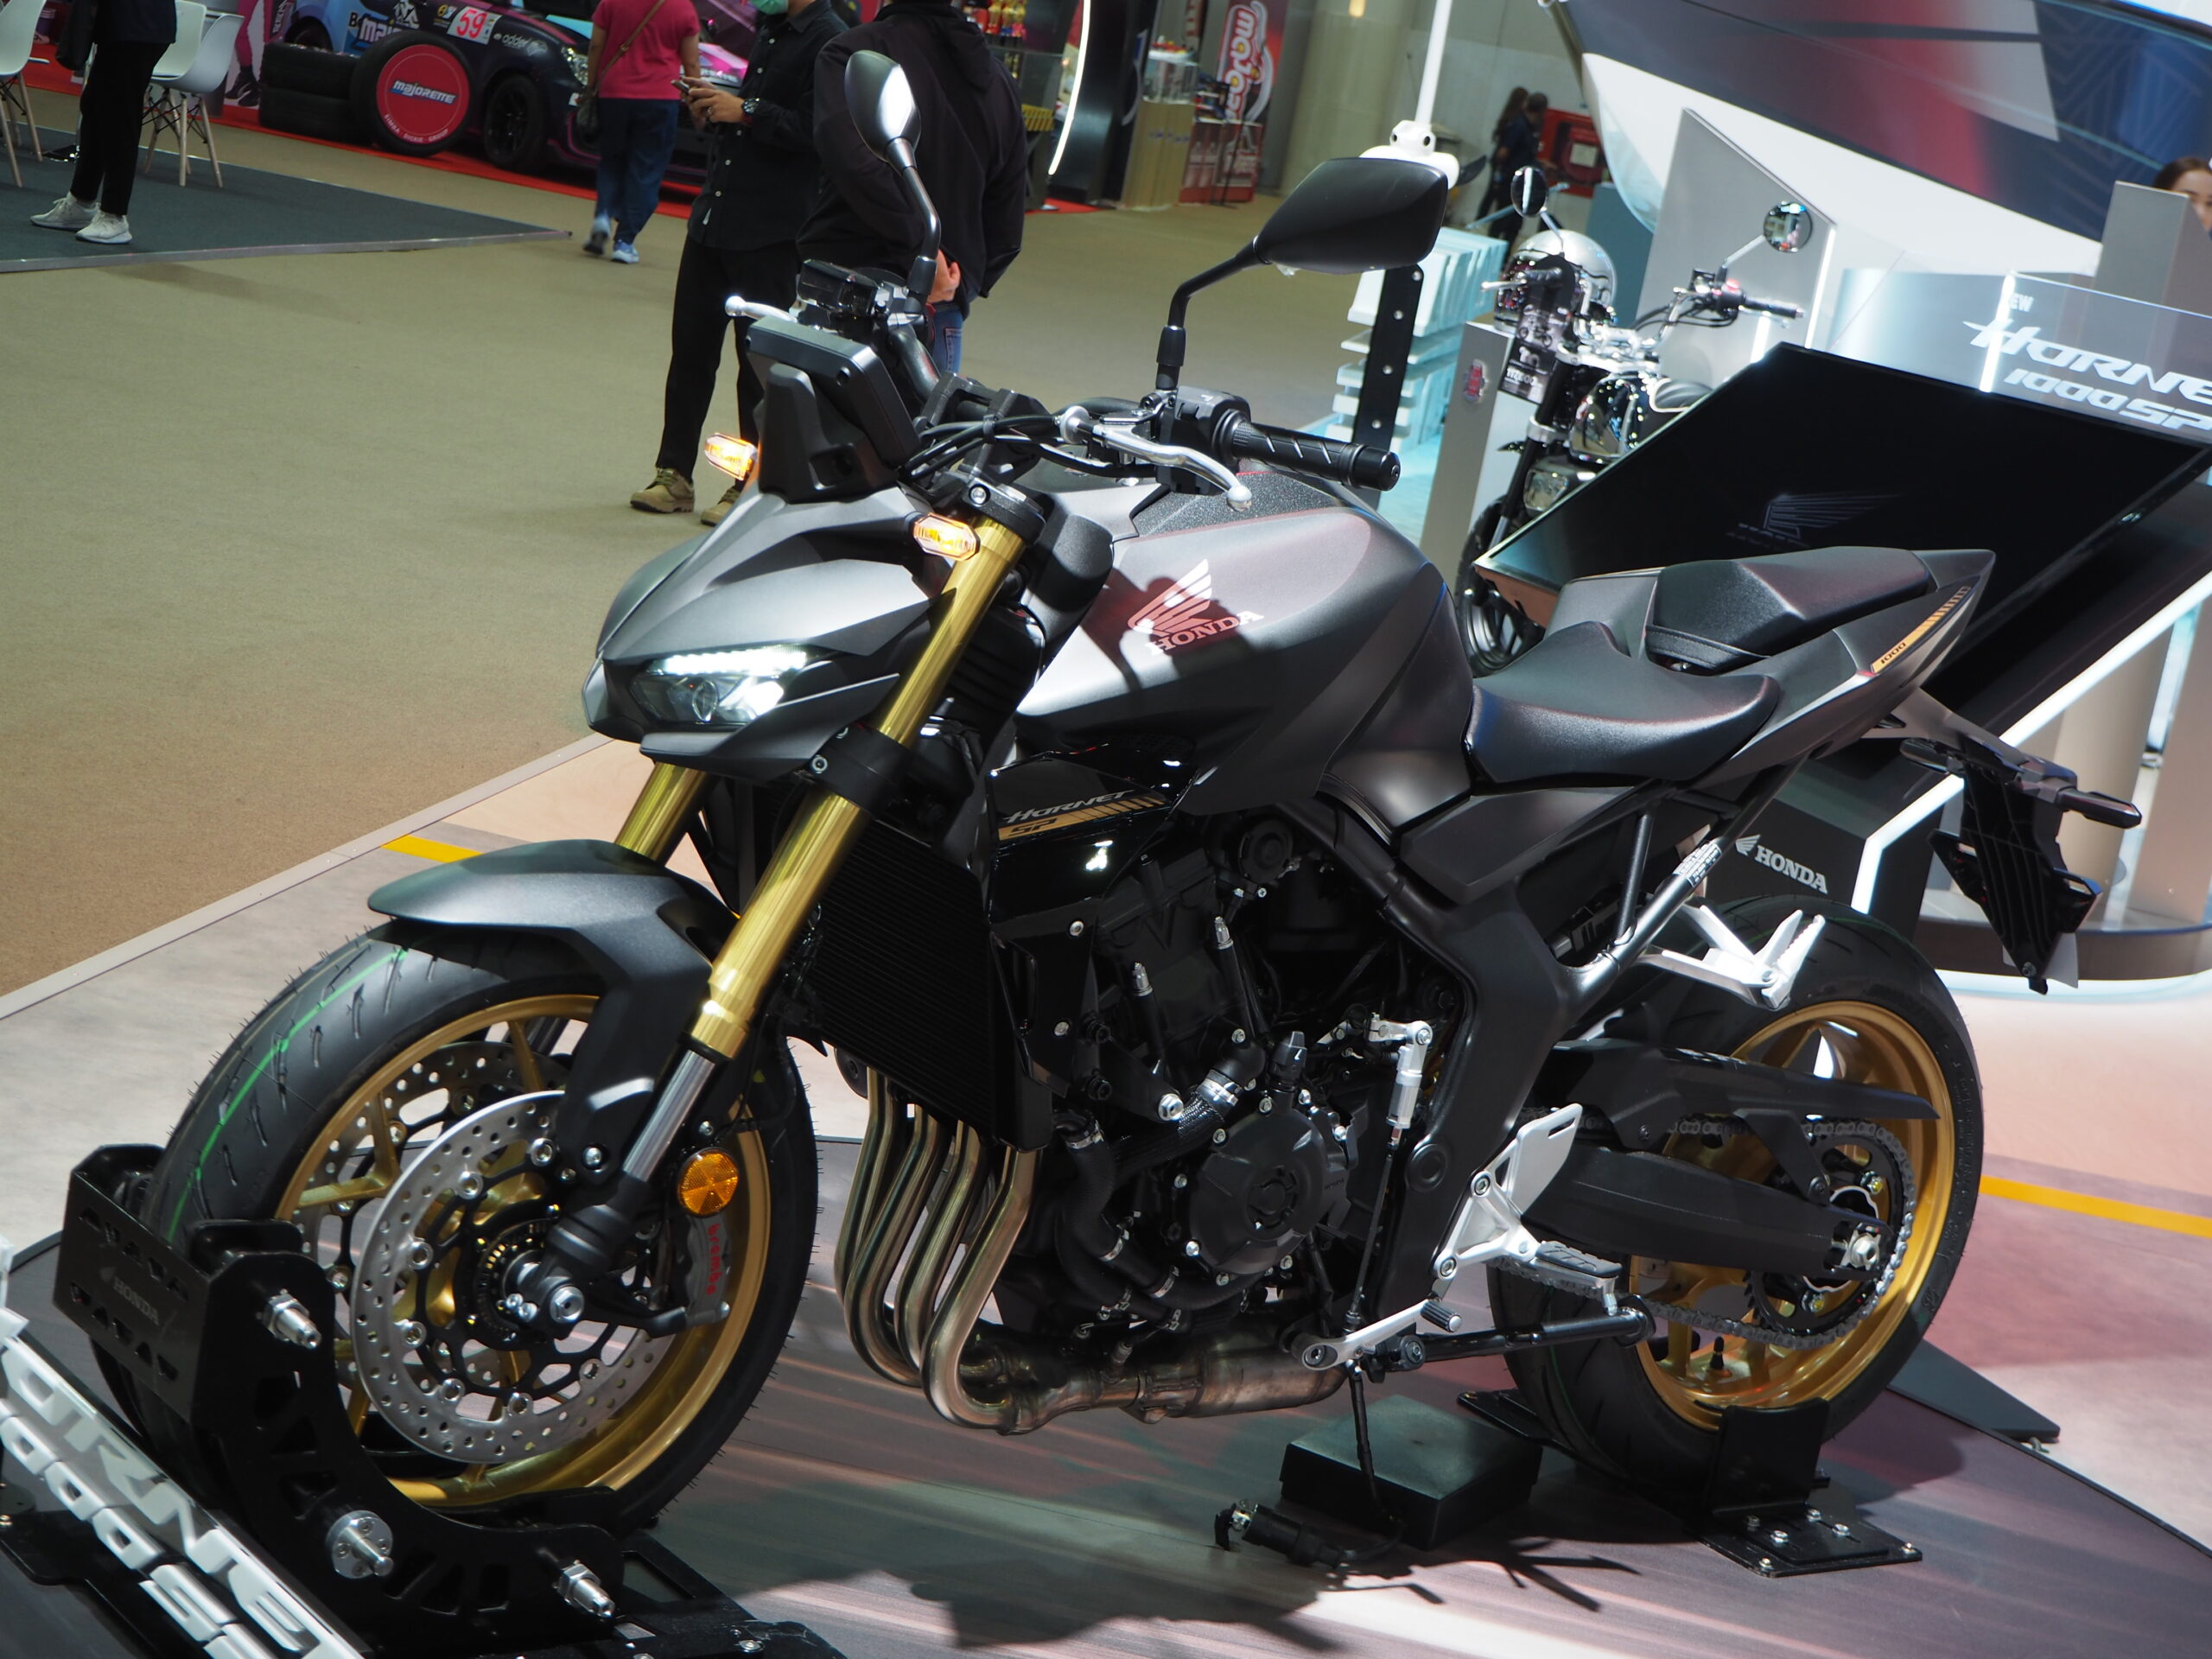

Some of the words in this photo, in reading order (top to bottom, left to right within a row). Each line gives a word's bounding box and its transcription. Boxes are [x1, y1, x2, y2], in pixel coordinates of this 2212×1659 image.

[456, 9, 486, 39] 59
[1145, 610, 1265, 656] HONDA
[1880, 642, 1906, 664] 1000
[1002, 790, 1135, 823] HORNET
[1007, 817, 1058, 837] SP
[1755, 845, 1828, 895] HONDA
[113, 1276, 160, 1326] HONDA
